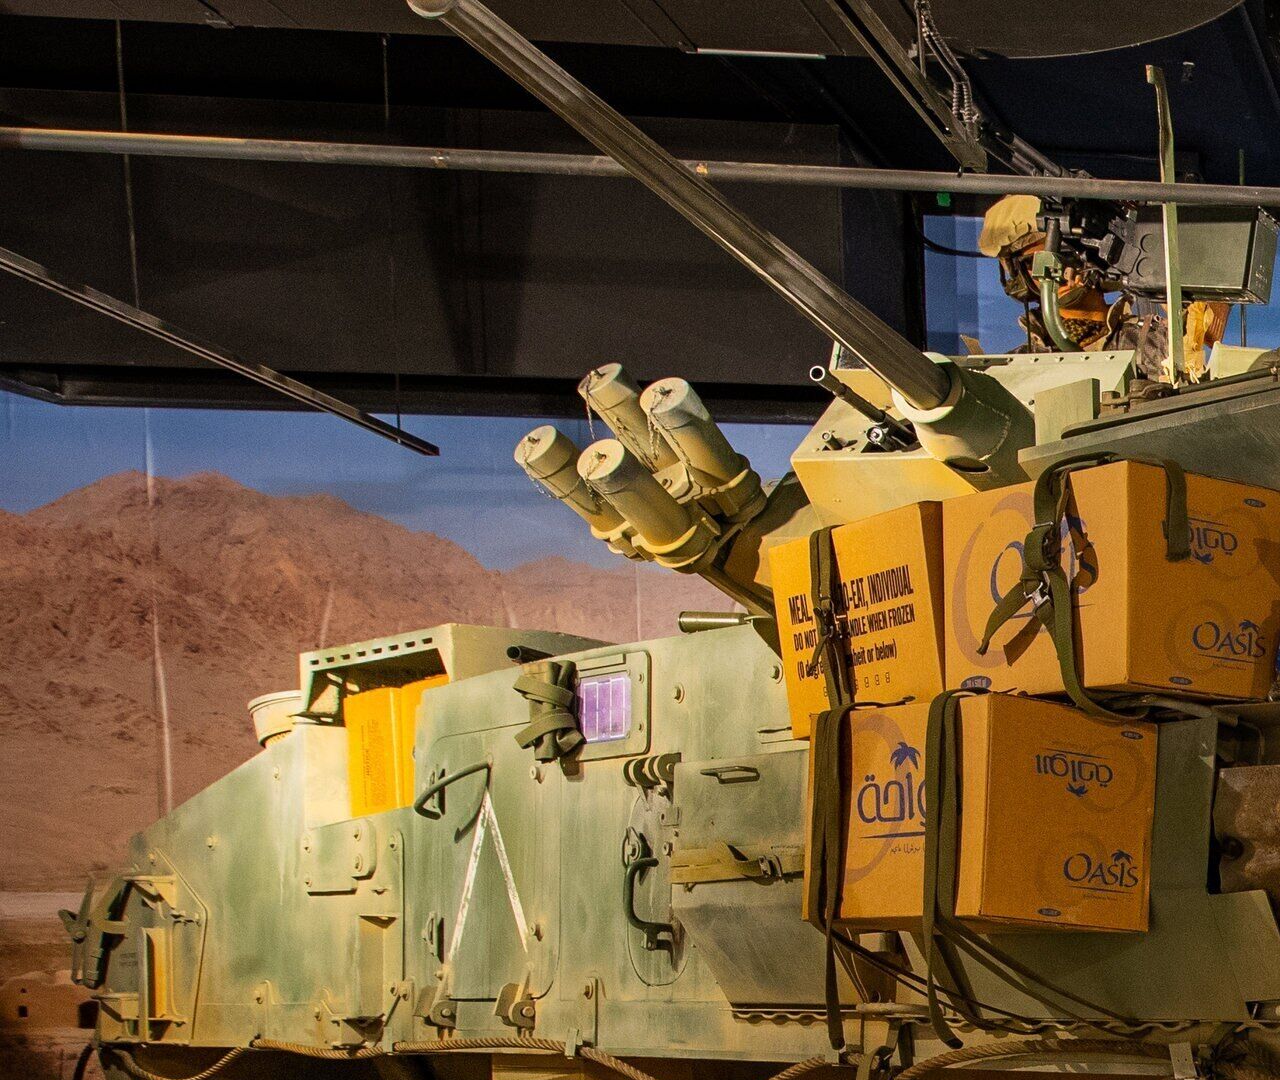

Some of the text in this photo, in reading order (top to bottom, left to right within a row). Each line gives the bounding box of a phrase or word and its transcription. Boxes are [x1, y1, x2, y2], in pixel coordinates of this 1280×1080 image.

[789, 594, 813, 625] MEAL,
[867, 565, 914, 604] INDIVIDUAL
[793, 633, 804, 651] DO
[804, 629, 817, 649] NOT
[867, 609, 888, 632] WHEN
[888, 603, 915, 628] FROZEN
[1192, 621, 1266, 657] OASIS
[875, 639, 897, 662] below)
[1063, 852, 1139, 888] OASIS
